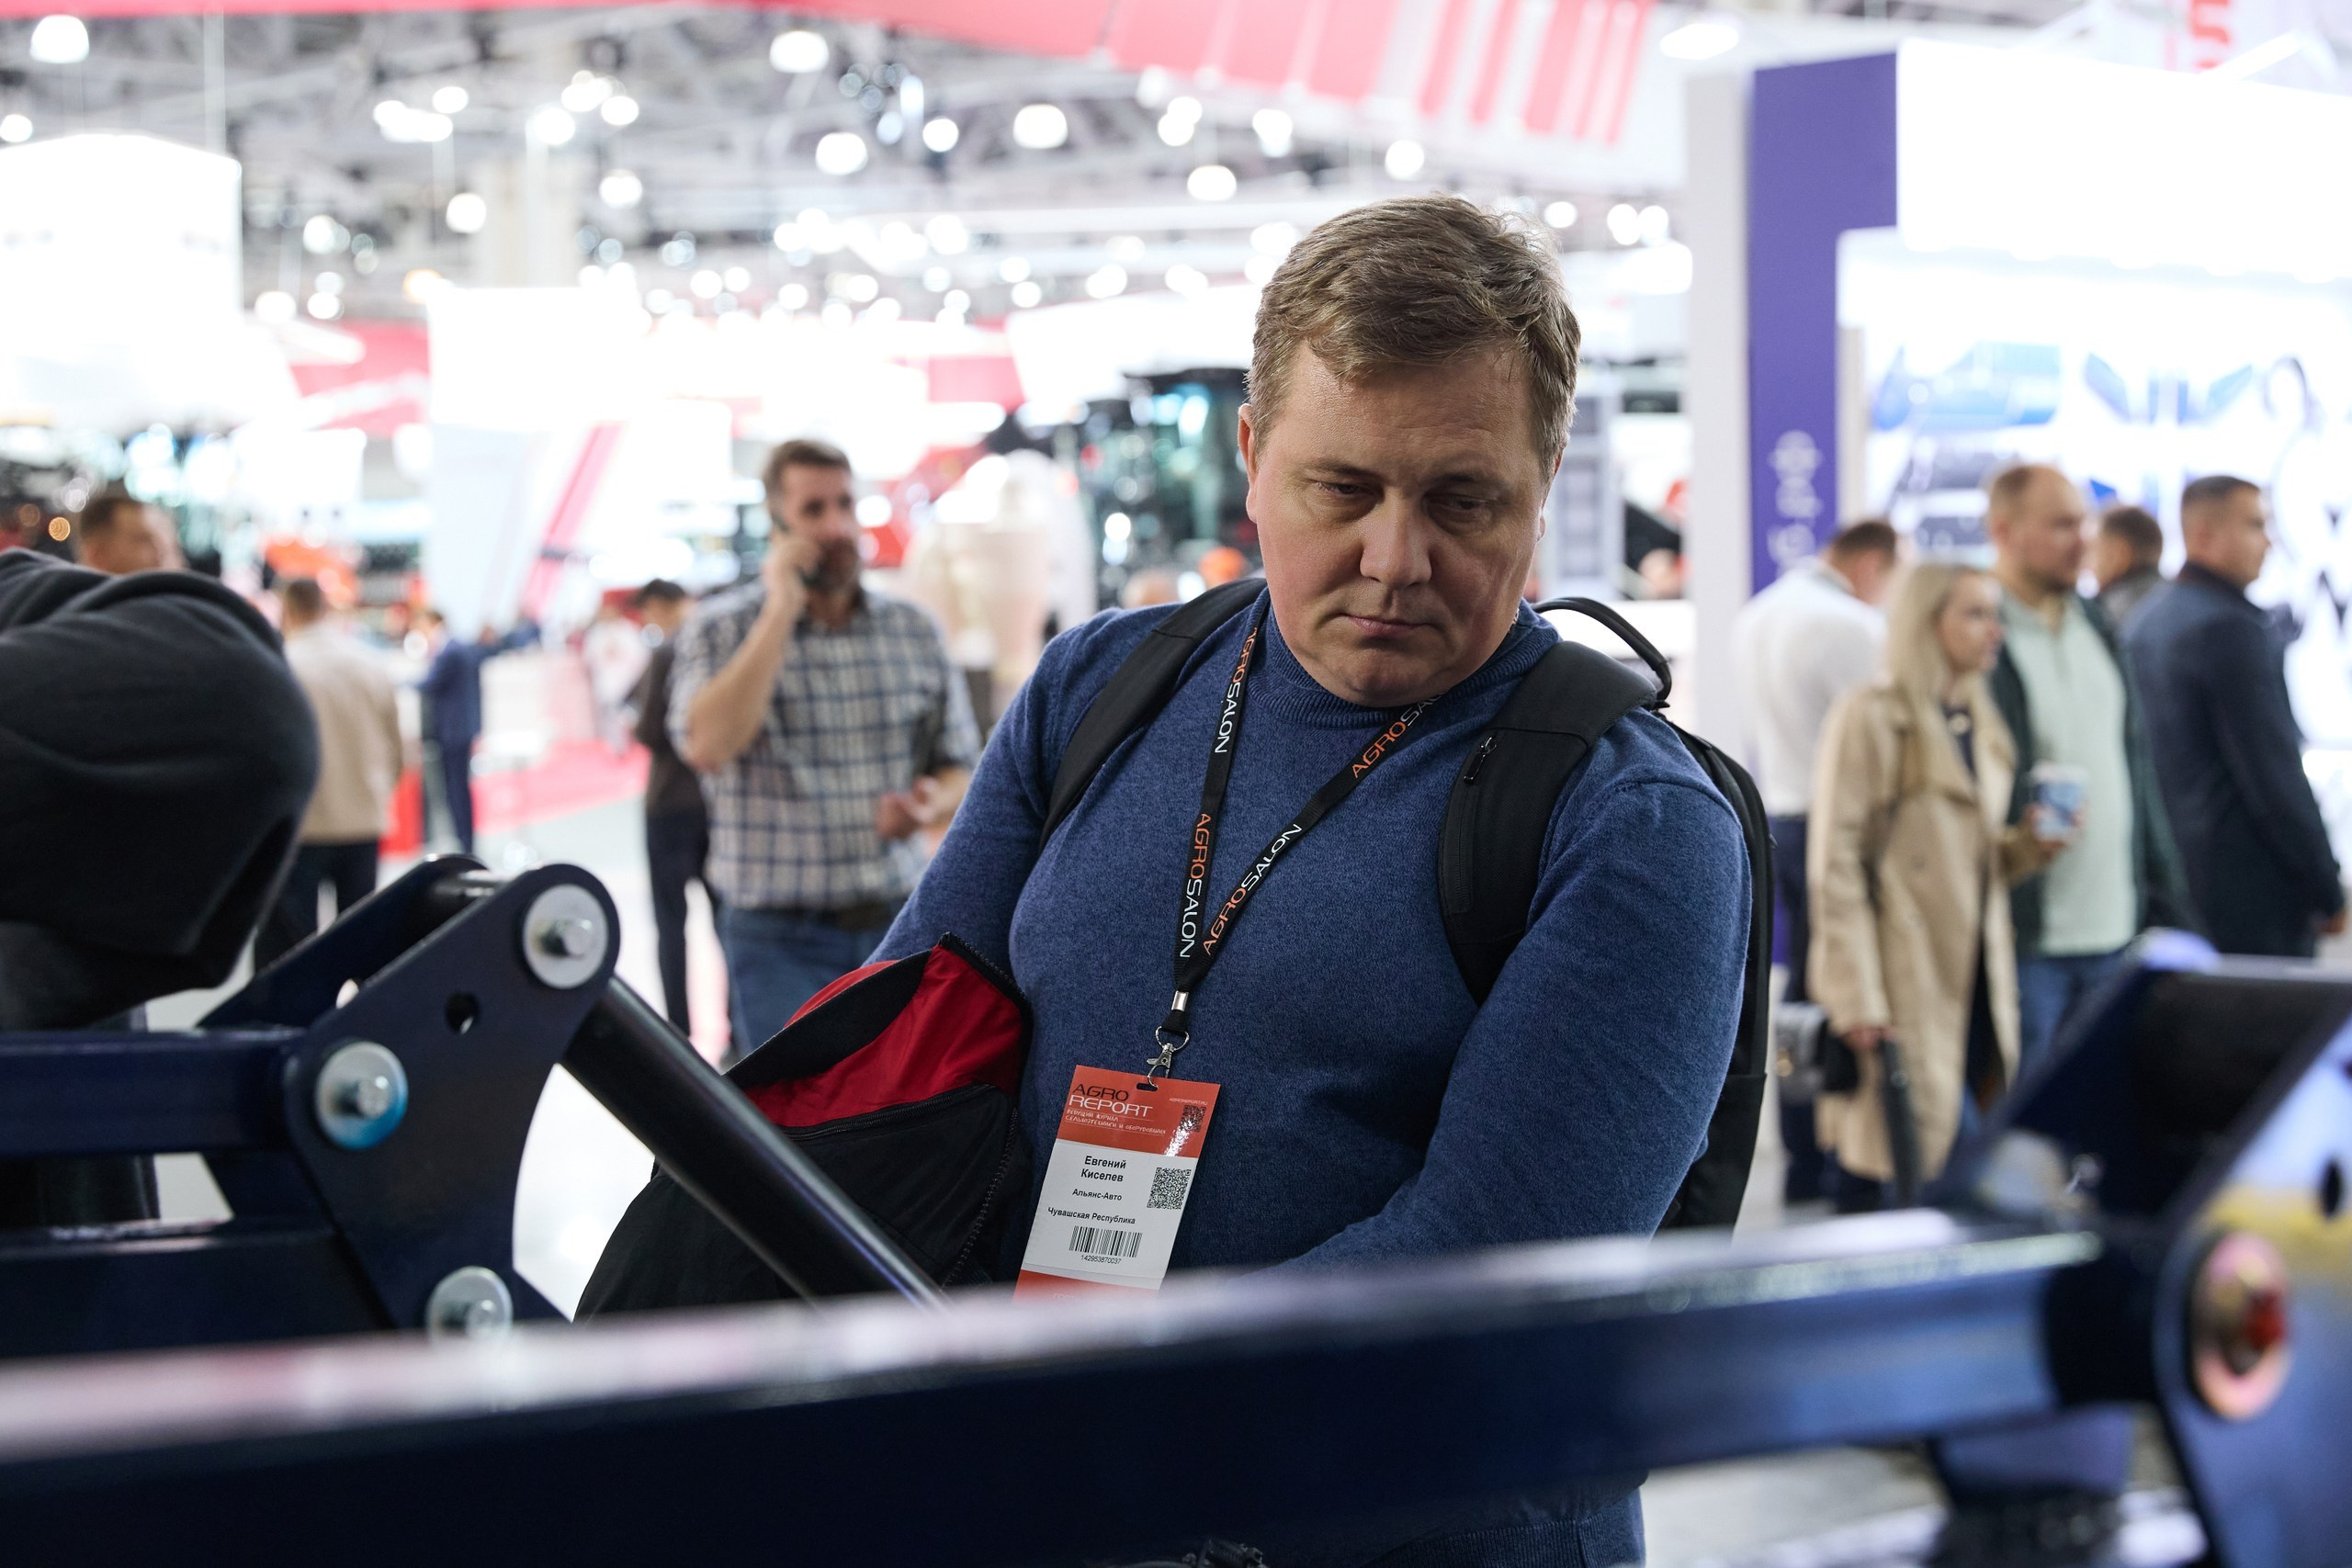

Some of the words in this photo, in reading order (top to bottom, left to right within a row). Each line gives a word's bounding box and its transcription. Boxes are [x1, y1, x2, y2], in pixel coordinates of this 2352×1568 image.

[1179, 813, 1212, 958] AGROSALON
[1203, 823, 1303, 955] AGROSALON
[1072, 1084, 1129, 1101] AGRO
[1069, 1094, 1154, 1118] REPORT
[1084, 1155, 1126, 1169] Евгений
[1080, 1168, 1124, 1182] Киселев
[1071, 1188, 1123, 1201] Альянс-Авто
[1047, 1206, 1091, 1219] Чувашская
[1091, 1213, 1136, 1224] Республика
